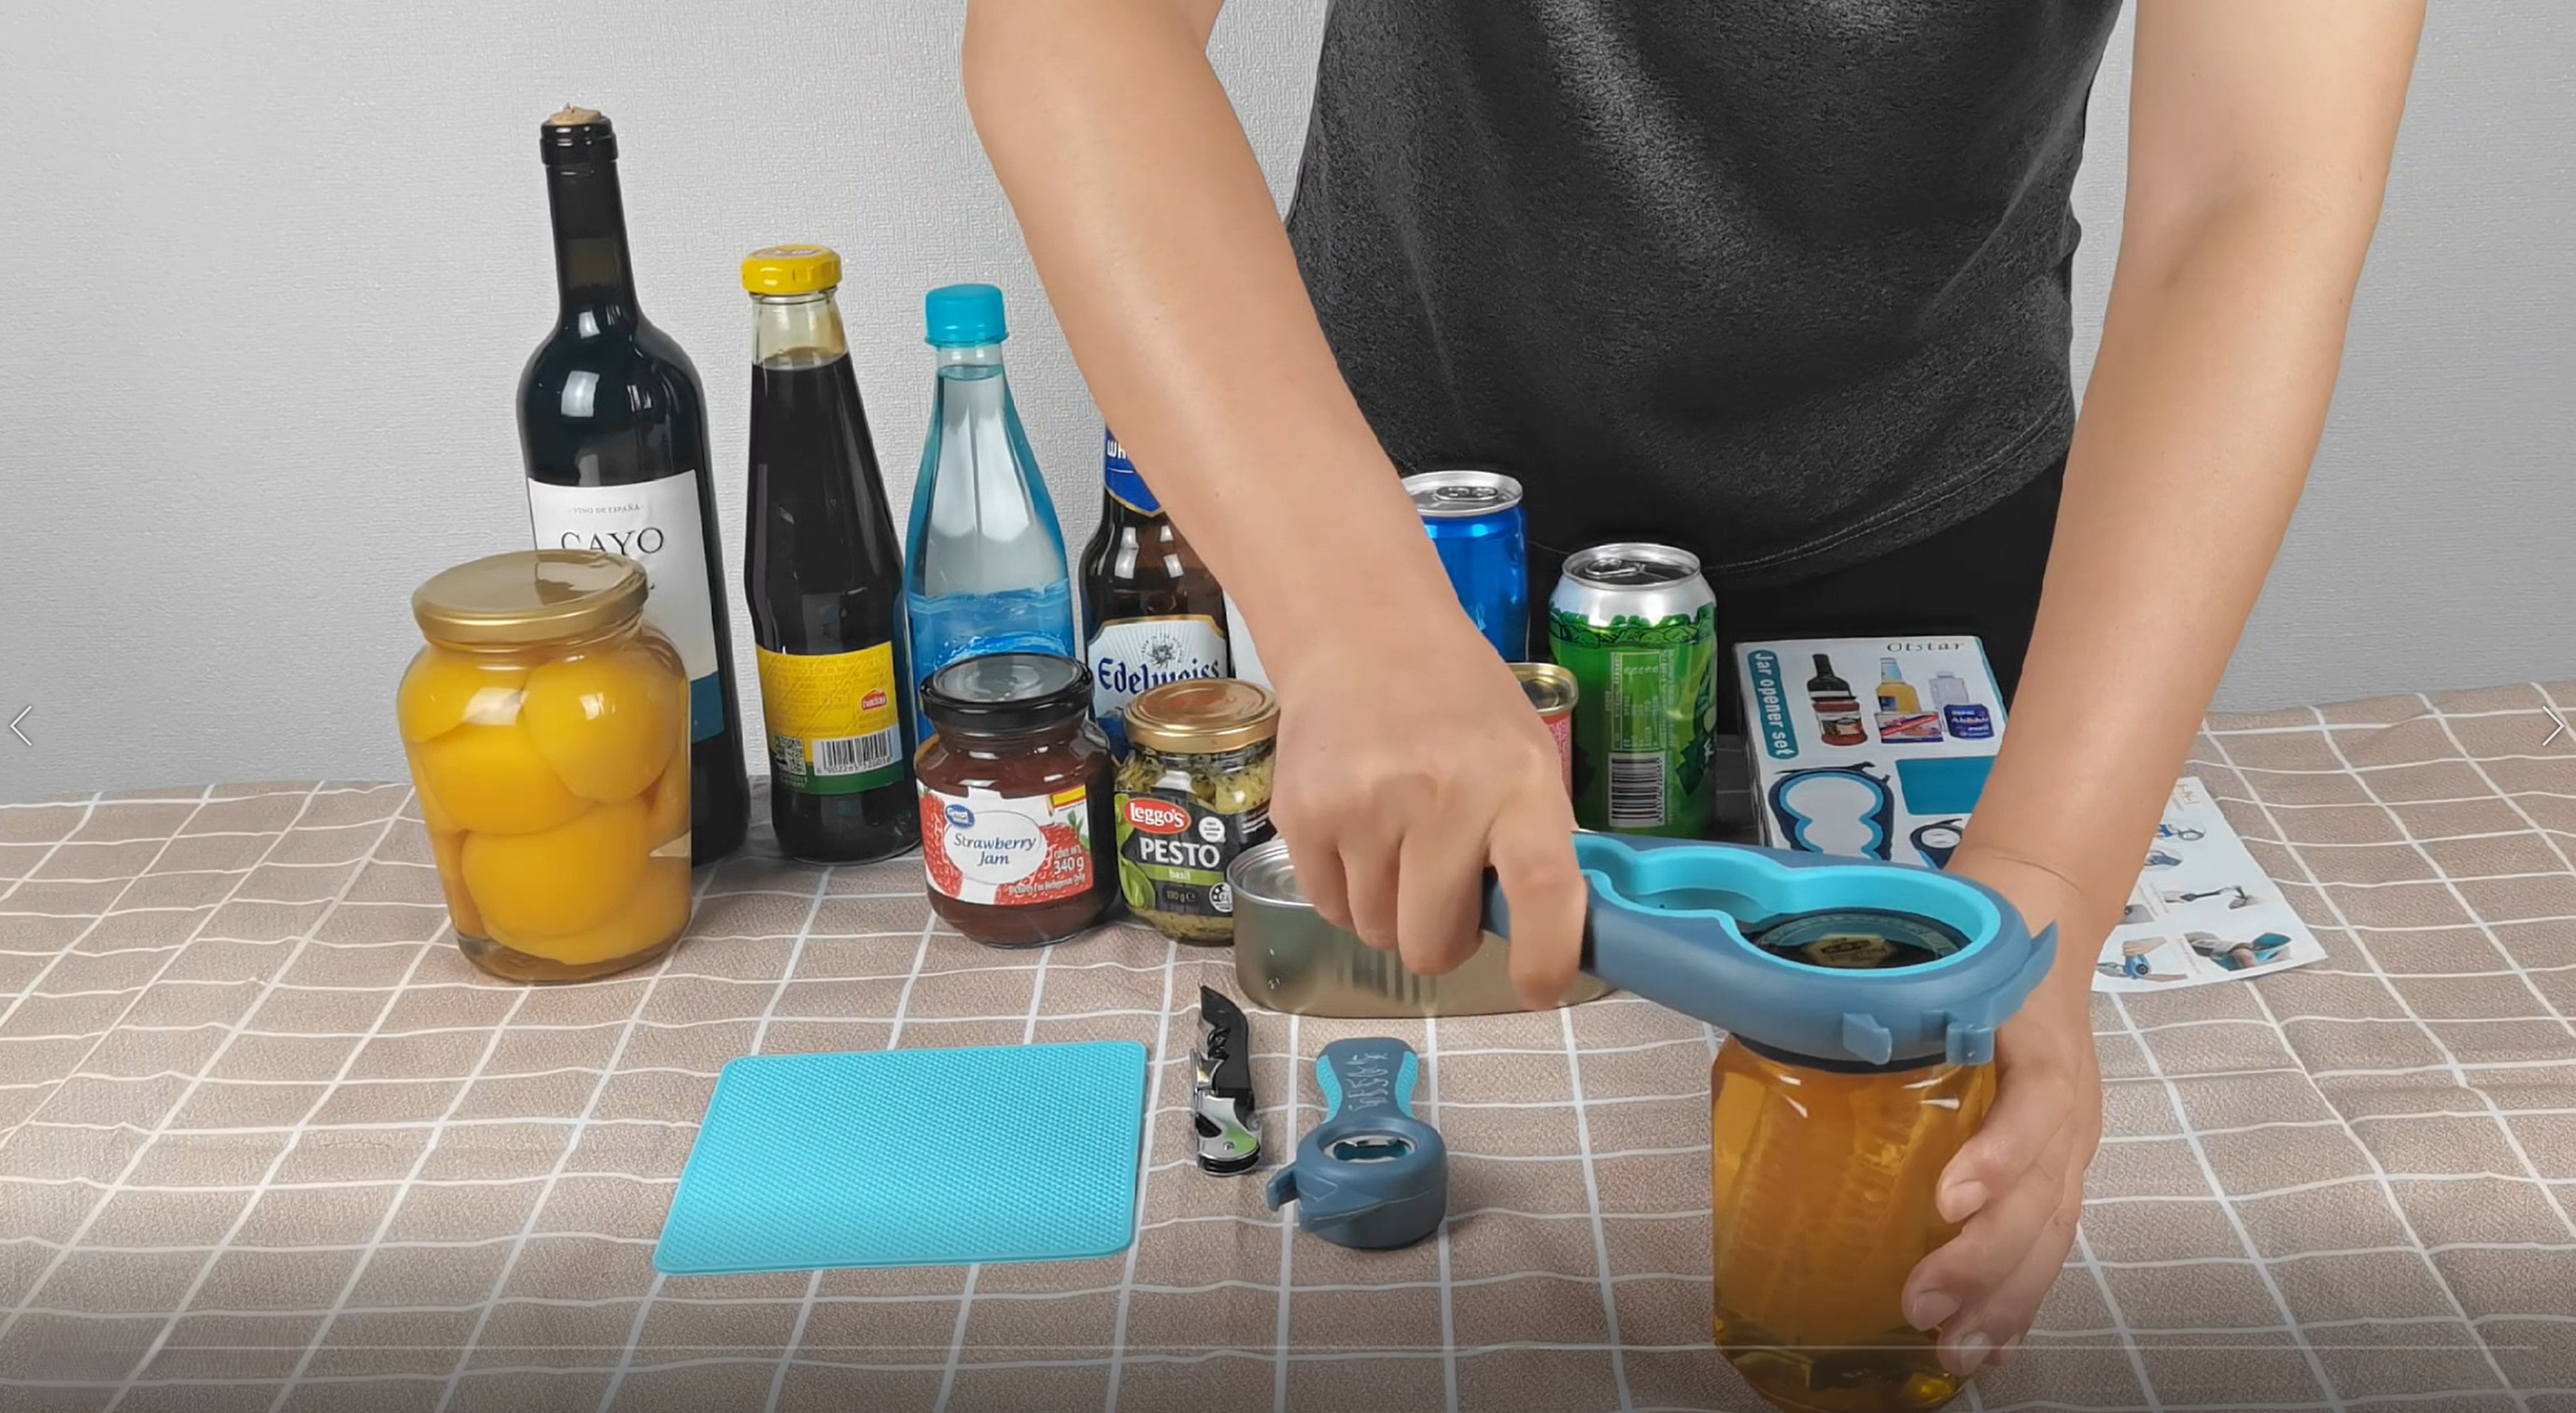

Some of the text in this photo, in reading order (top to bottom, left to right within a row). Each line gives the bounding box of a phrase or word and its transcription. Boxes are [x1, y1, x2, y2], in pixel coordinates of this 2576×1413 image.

[608, 503, 640, 515] ESPAÑA
[560, 527, 664, 557] CAYO
[1754, 653, 1795, 756] Jar opener set
[1129, 802, 1186, 828] Leggo's
[953, 833, 1036, 852] Strawberry
[977, 851, 1010, 867] Jam
[1139, 837, 1220, 869] PESTO
[1053, 856, 1084, 875] 340 g
[1168, 868, 1190, 881] basil
